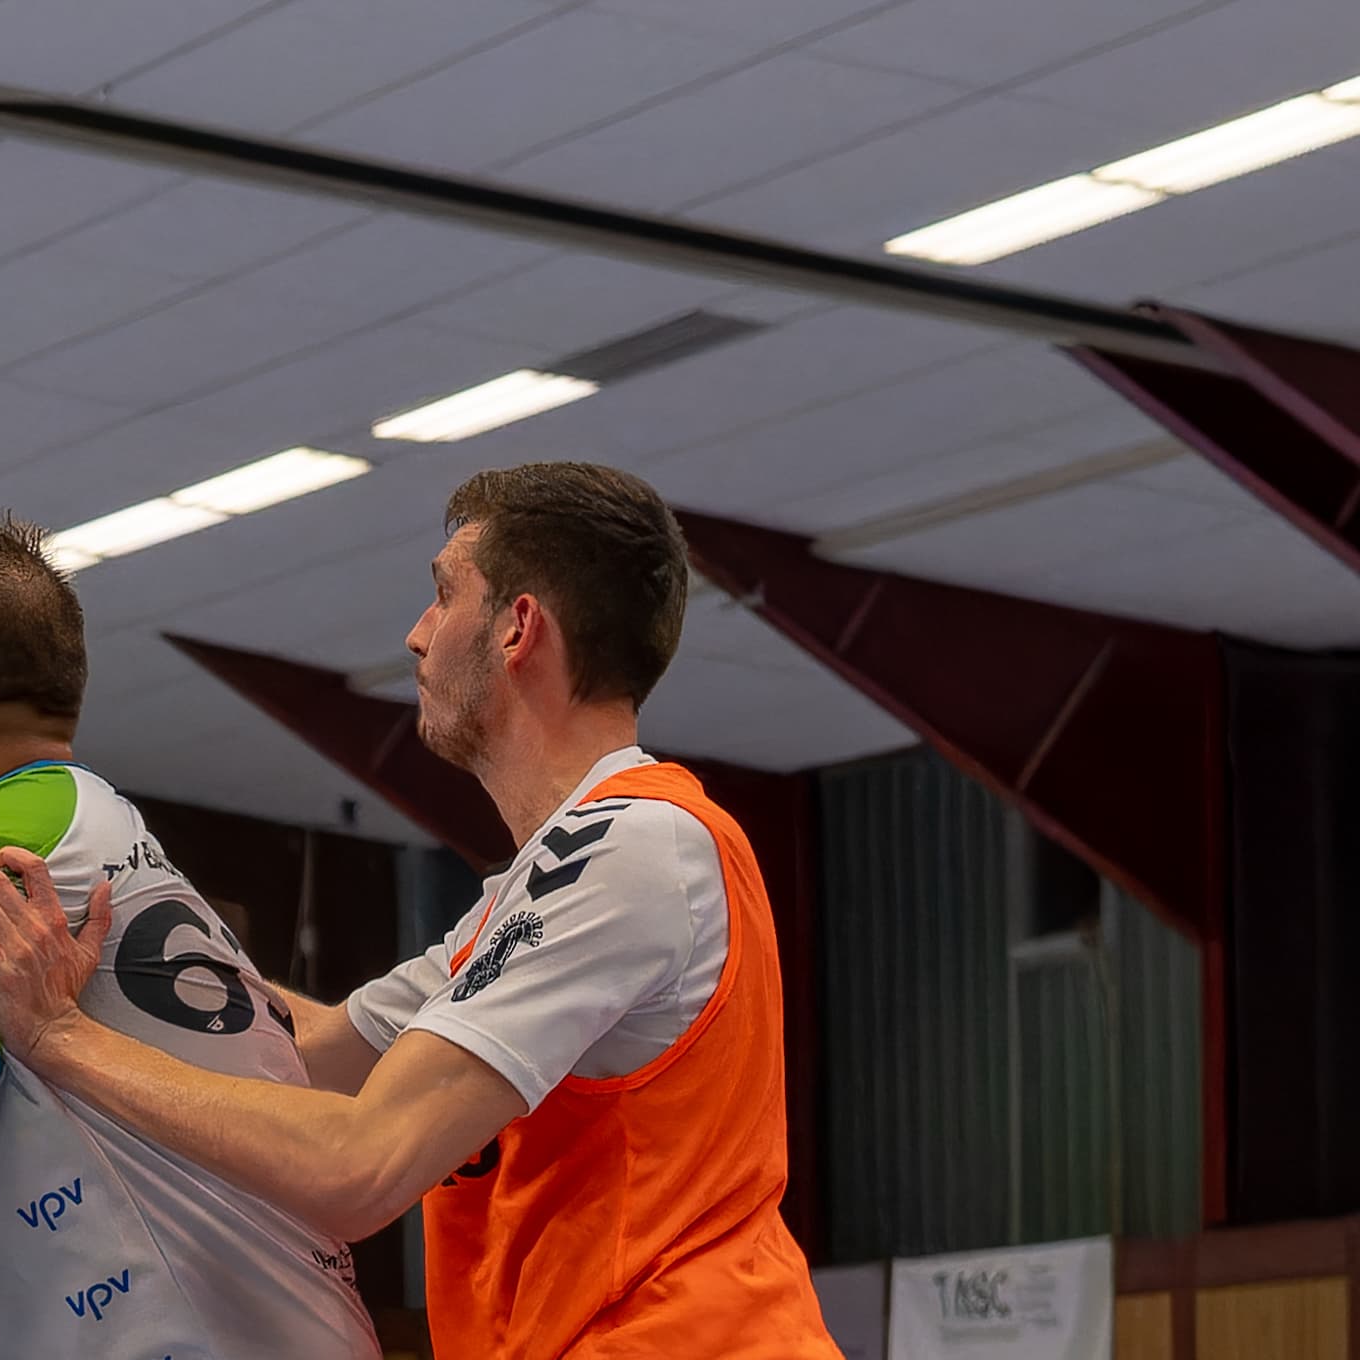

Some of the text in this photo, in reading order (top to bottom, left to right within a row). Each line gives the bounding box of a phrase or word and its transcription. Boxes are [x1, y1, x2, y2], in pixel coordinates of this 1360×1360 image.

[114, 899, 296, 1039] 6
[16, 1176, 83, 1232] vpv
[65, 1268, 130, 1322] vpv
